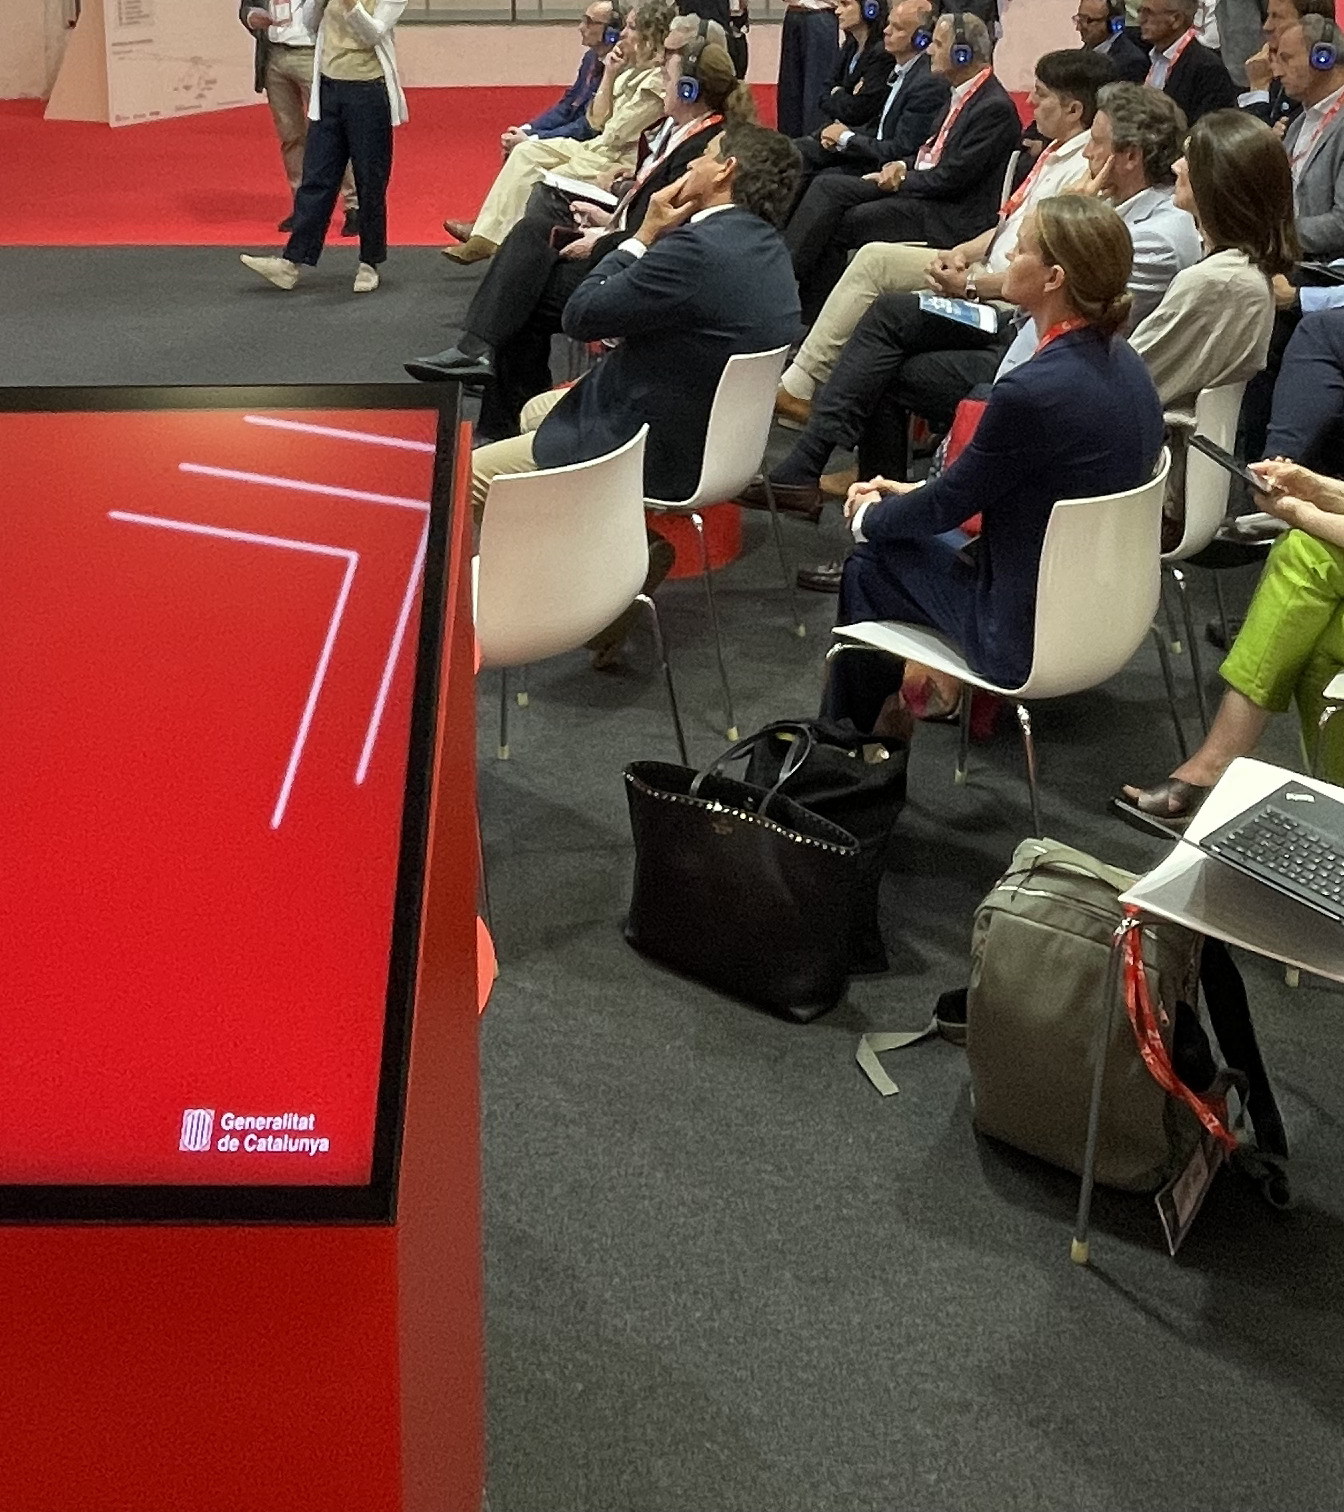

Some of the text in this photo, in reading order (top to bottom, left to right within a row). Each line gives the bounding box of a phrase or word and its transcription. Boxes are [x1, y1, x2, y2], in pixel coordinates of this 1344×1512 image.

[220, 1112, 316, 1131] Generalitat
[217, 1134, 330, 1157] de Catalunya
